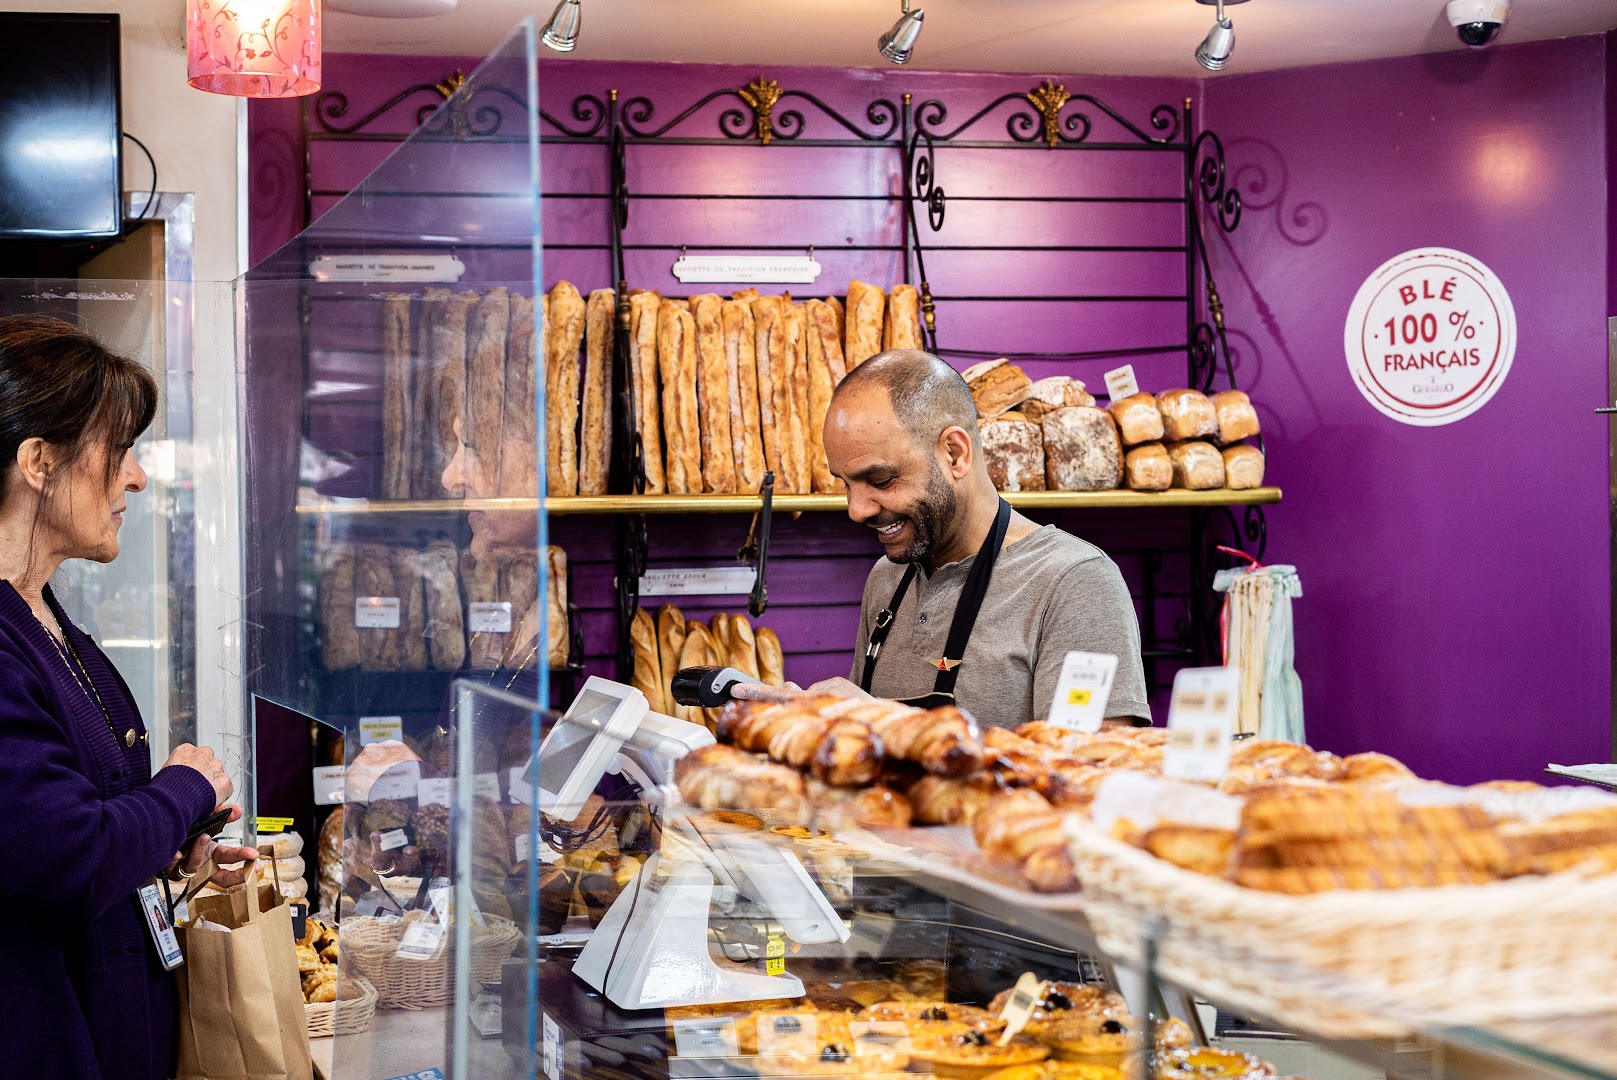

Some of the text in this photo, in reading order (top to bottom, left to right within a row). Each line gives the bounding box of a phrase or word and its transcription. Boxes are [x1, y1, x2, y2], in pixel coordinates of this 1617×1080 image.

[1398, 277, 1457, 306] BLÉ
[1384, 310, 1475, 346] 100 %
[1384, 348, 1480, 374] FRANÇAIS
